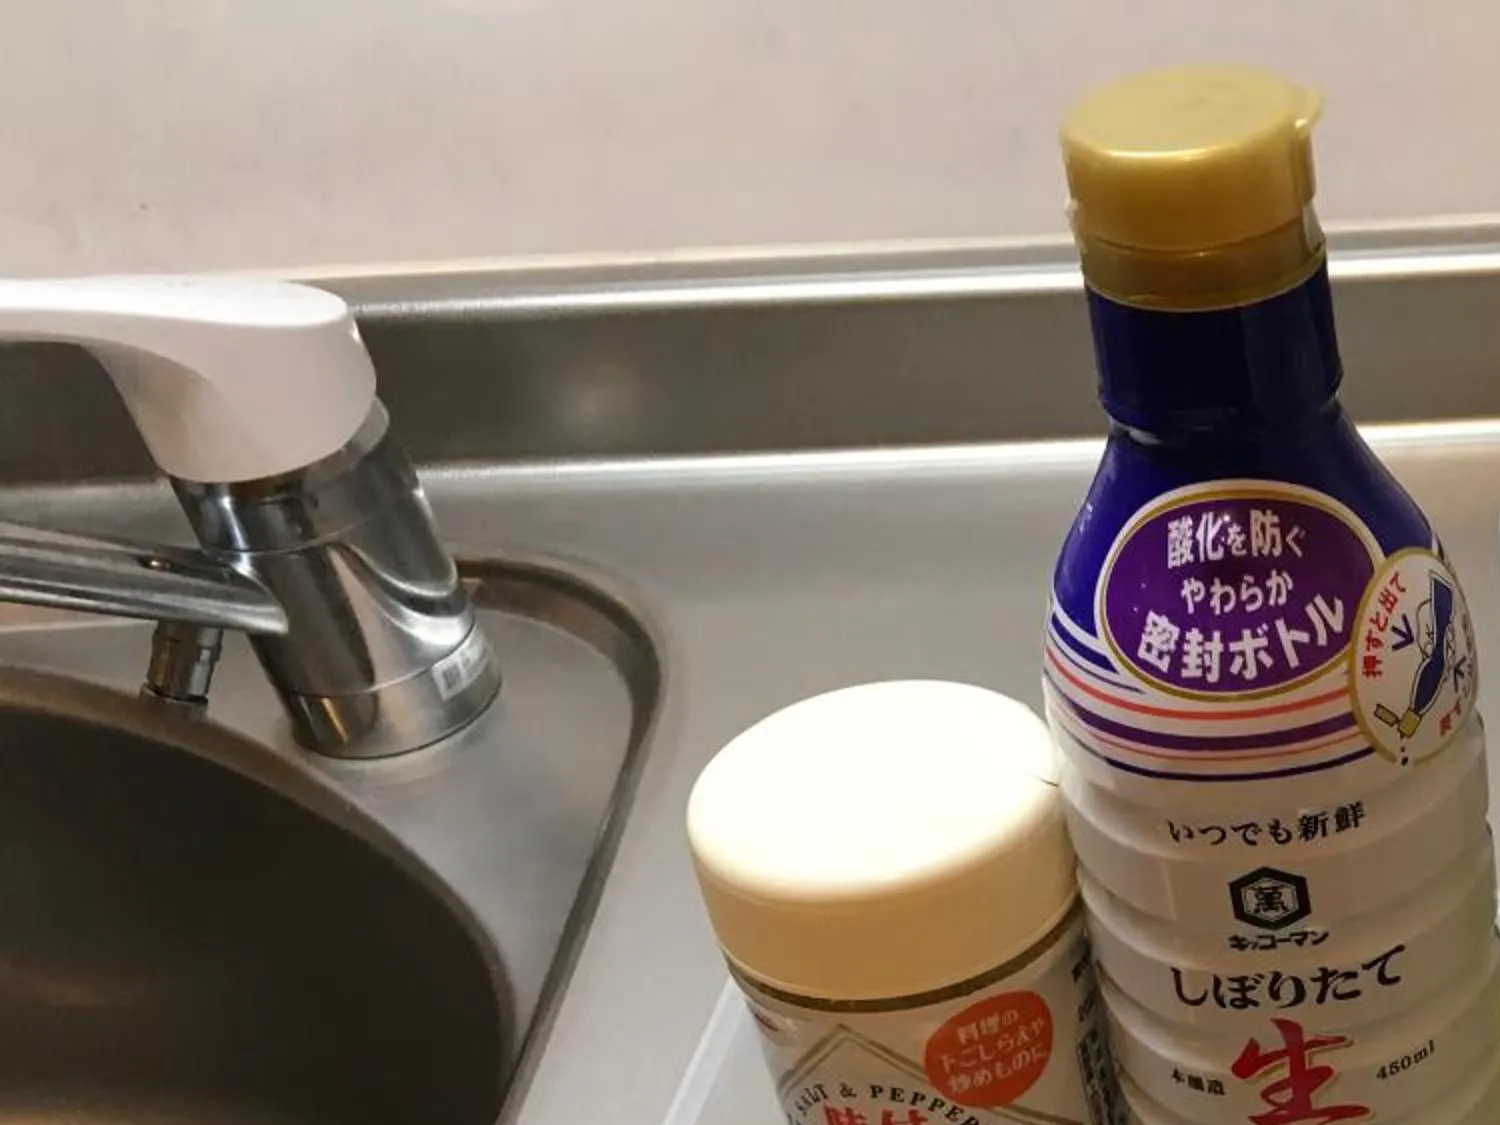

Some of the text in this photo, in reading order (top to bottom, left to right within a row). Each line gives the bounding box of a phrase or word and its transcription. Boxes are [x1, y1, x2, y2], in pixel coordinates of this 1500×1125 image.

[1167, 509, 1305, 568] 酸化を防ぐ
[1180, 570, 1295, 615] やわらか
[1137, 593, 1346, 683] 密封ボトル
[1361, 571, 1408, 680] 押すと出て
[1167, 801, 1367, 847] いつでも新鮮
[1228, 929, 1330, 951] キッコーマン
[1170, 943, 1407, 1009] しぼりたて
[955, 1008, 1019, 1046] 料理の
[839, 1083, 858, 1100] &
[950, 1046, 1046, 1093] 炒めものに
